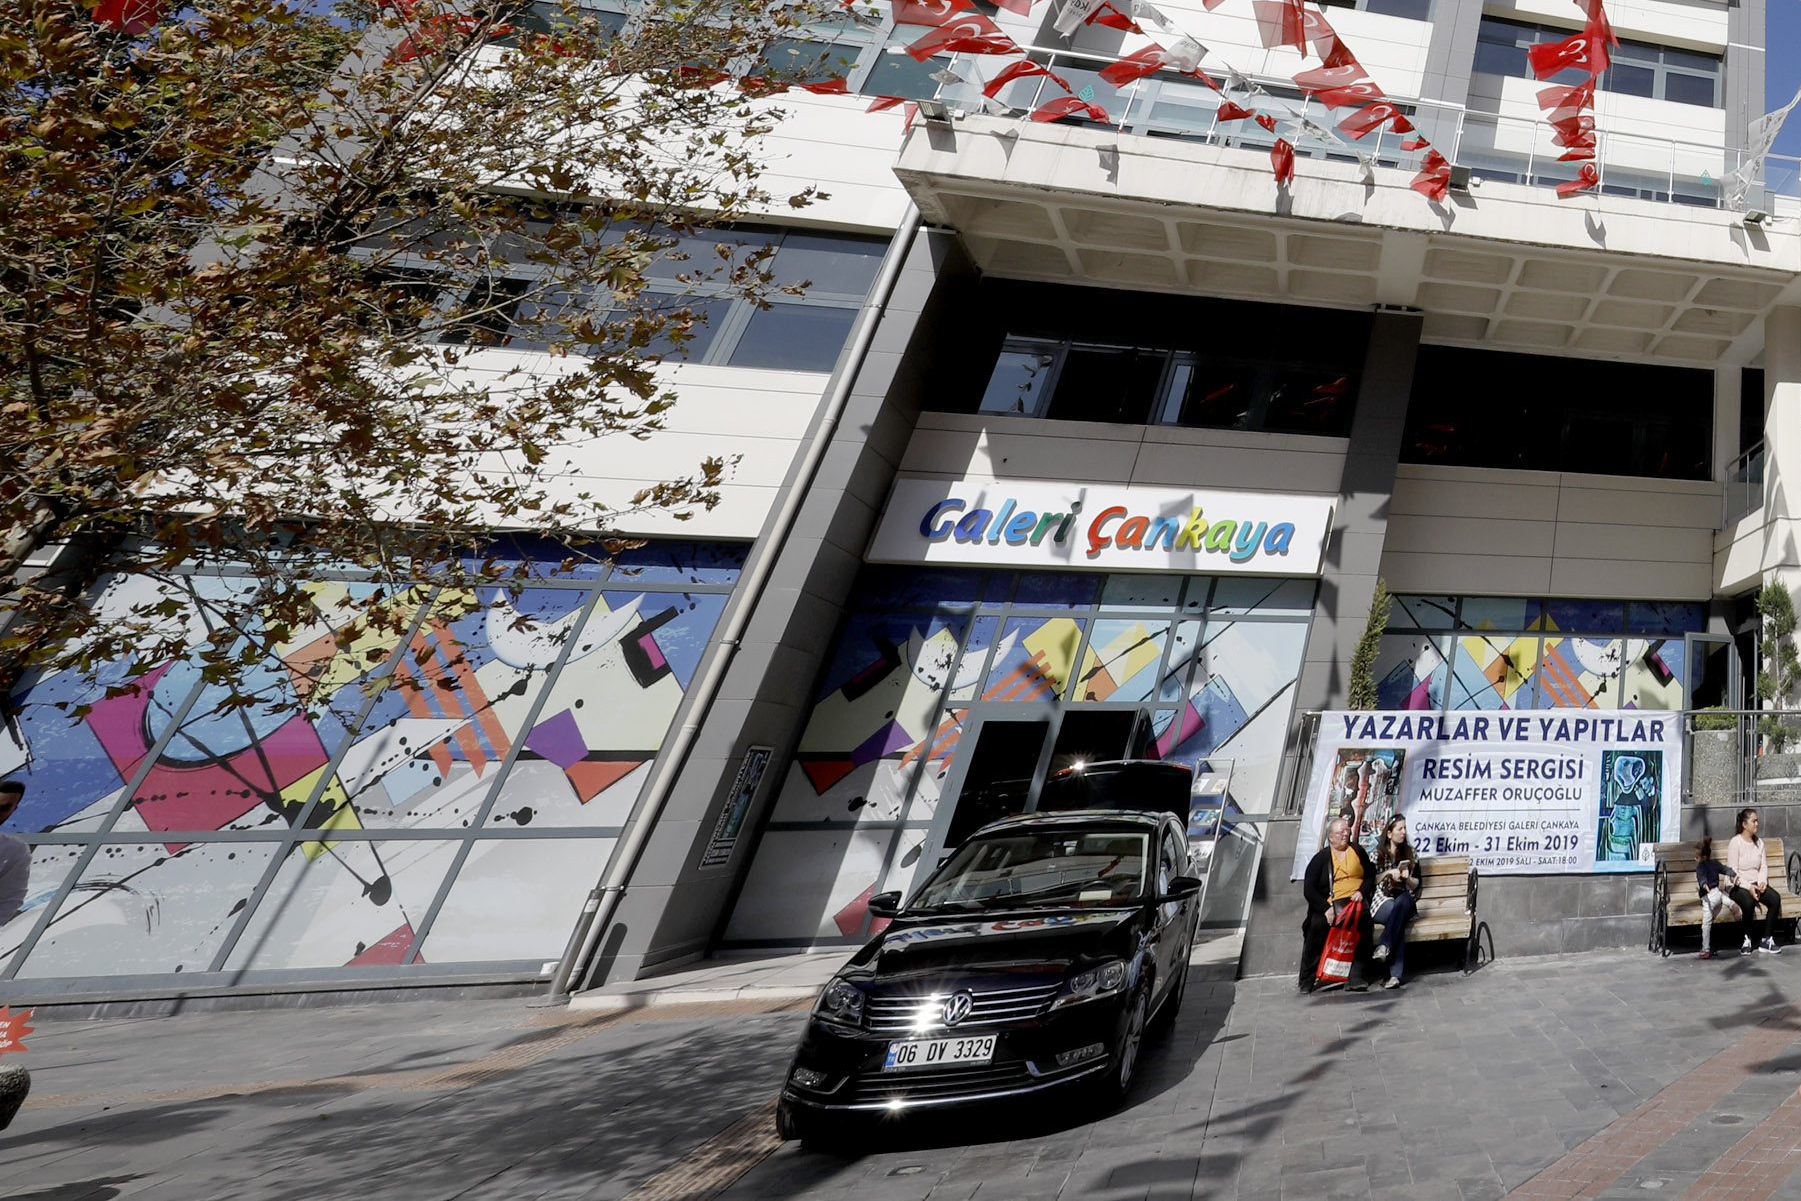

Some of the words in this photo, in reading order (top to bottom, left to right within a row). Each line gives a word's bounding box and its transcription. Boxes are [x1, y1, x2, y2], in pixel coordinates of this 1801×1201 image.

[919, 498, 1083, 544] Galeri
[1086, 505, 1295, 561] Çankaya
[1343, 715, 1489, 740] YAZARLAR
[1498, 717, 1530, 741] VE
[1539, 718, 1665, 742] YAPITLAR
[1422, 752, 1492, 779] RESİM
[1500, 753, 1584, 780] SERGİSİ
[1419, 787, 1498, 802] MUZAFFER
[1502, 784, 1582, 805] ORUÇOĞLU
[1415, 821, 1456, 833] ÇANKAYA
[1541, 820, 1580, 833] ÇANKAYA
[1413, 837, 1430, 853] 22
[1436, 837, 1470, 853] Ekim
[1484, 836, 1500, 851] 31
[1507, 835, 1539, 851] Ekim
[1544, 835, 1579, 851] 2019
[1476, 856, 1494, 866] EKİM
[1496, 857, 1513, 866] 2019
[1515, 857, 1531, 865] SALI
[897, 1044, 918, 1064] 06
[926, 1041, 948, 1062] DV
[954, 1038, 993, 1059] 3329
